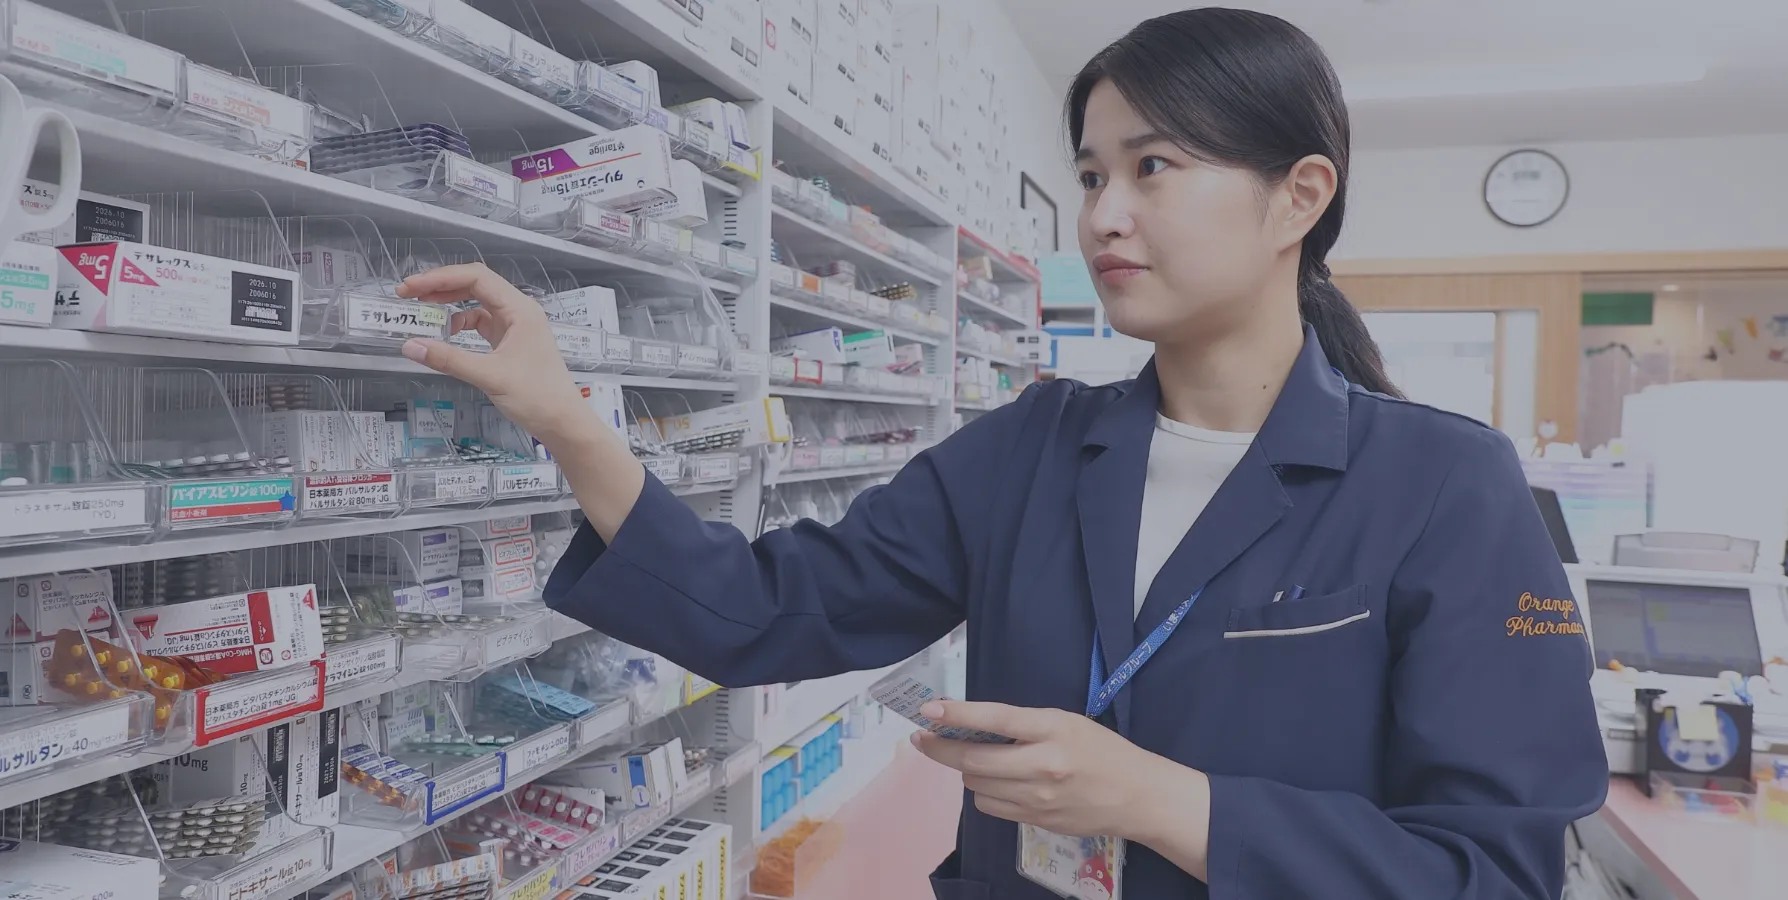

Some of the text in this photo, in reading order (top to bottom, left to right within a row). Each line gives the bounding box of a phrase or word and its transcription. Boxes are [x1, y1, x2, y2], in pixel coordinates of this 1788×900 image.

[588, 143, 618, 156] Tarlige
[78, 253, 109, 280] 5mg
[123, 266, 145, 283] 5mg
[248, 279, 277, 290] 2026.10
[1518, 591, 1575, 620] Orange
